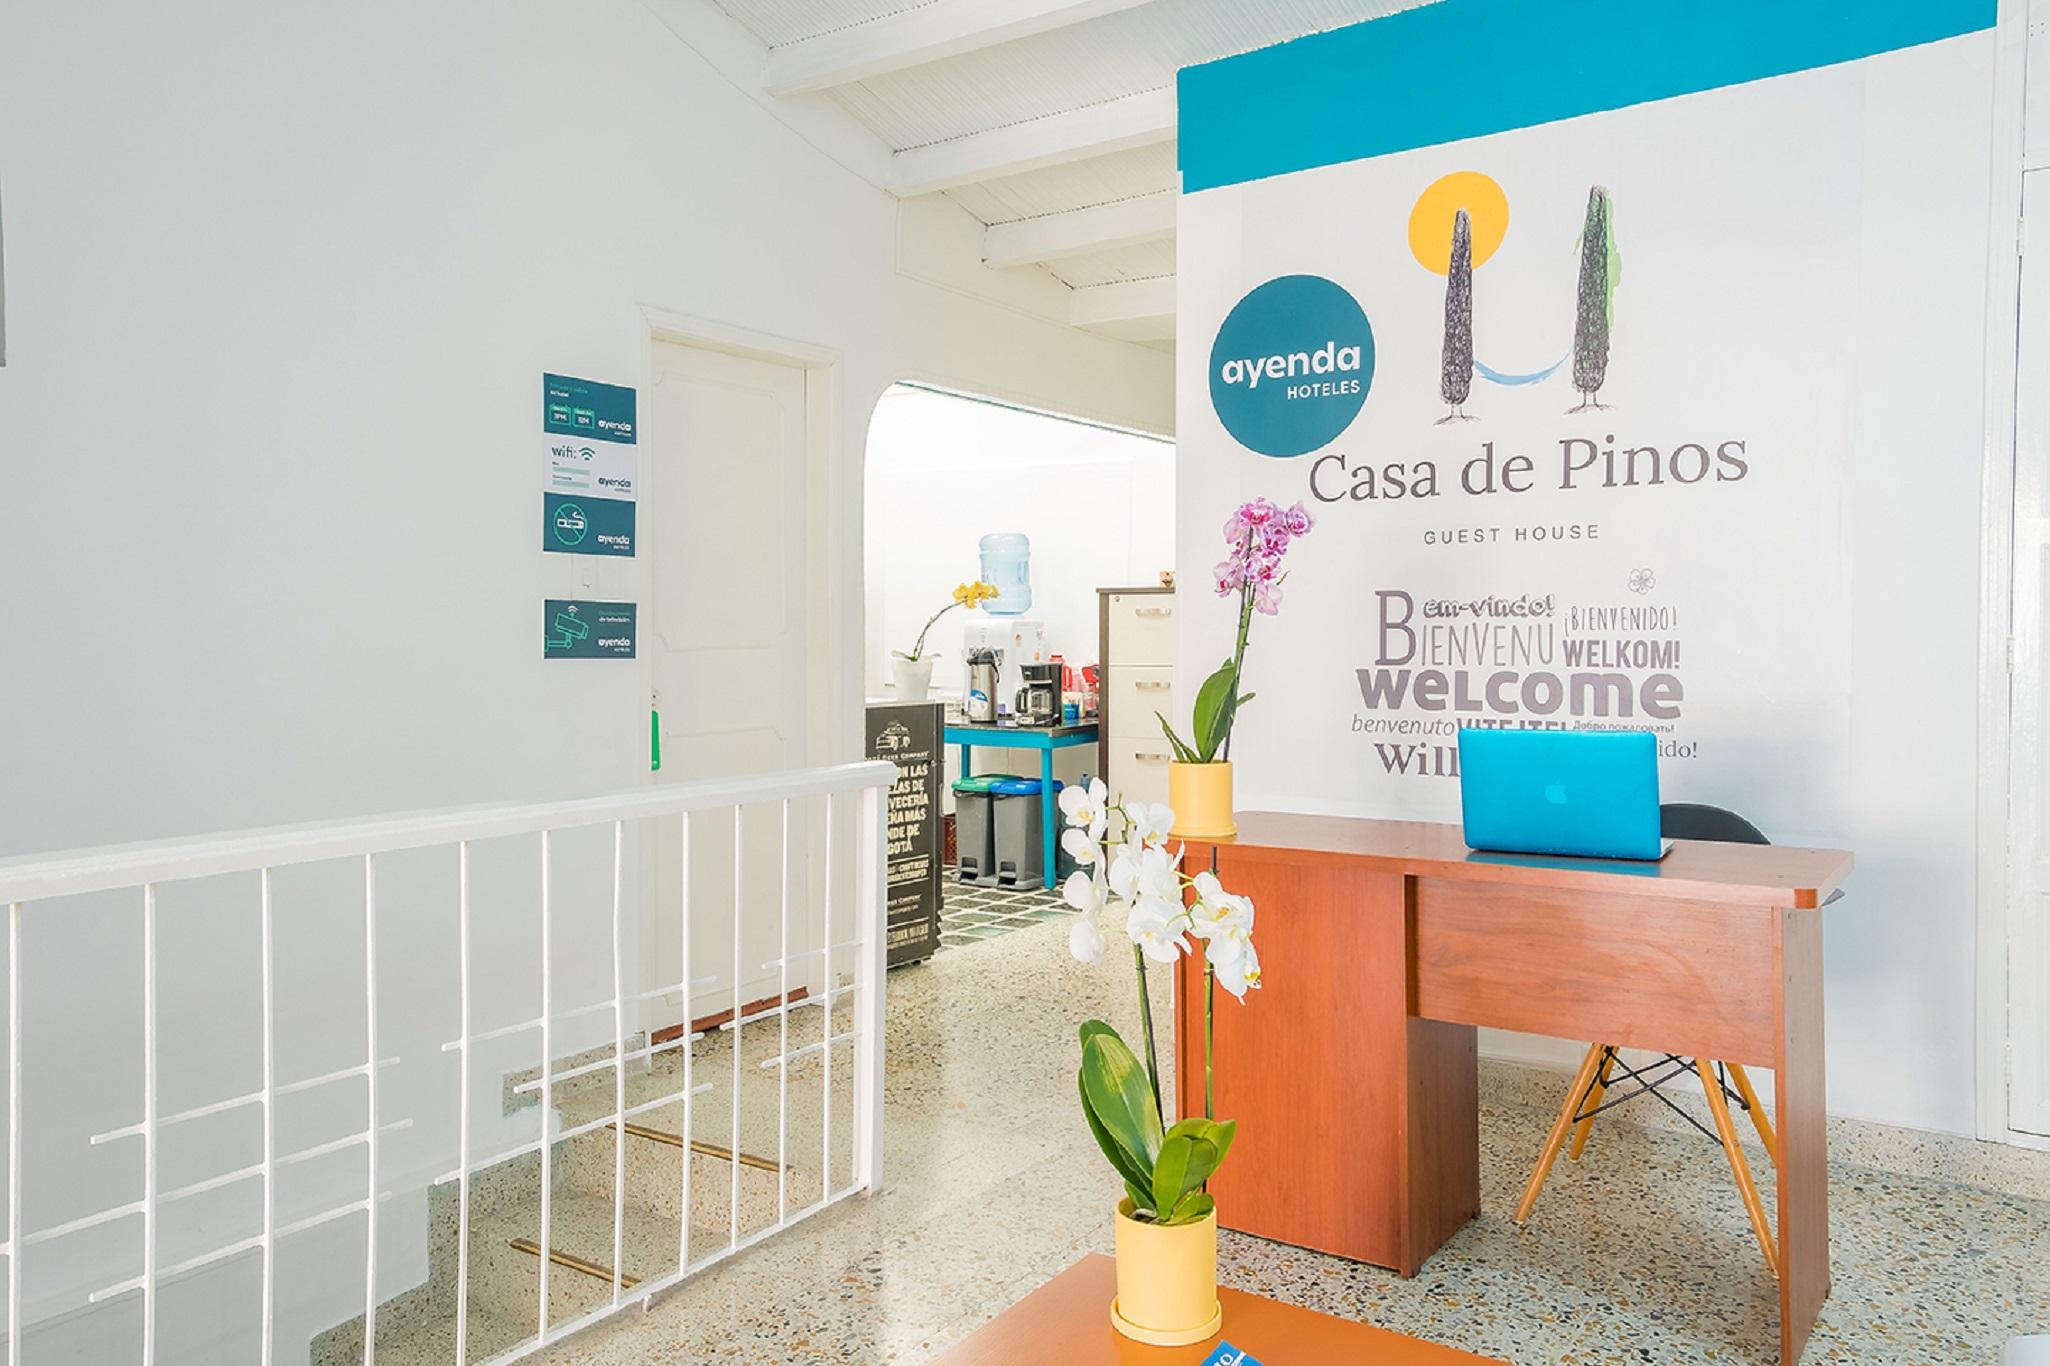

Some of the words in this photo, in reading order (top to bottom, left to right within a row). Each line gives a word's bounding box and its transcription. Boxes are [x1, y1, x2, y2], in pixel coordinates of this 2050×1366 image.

[1222, 341, 1361, 389] ayenda
[1287, 380, 1361, 400] HOTELES
[598, 419, 631, 432] ayenda
[1309, 454, 1441, 503] Casa
[1461, 441, 1535, 496] de
[1559, 434, 1750, 490] Pinos
[598, 477, 631, 489] ayenda
[597, 534, 630, 545] ayenda
[1424, 528, 1500, 545] GUEST
[1515, 524, 1599, 542] HOUSE
[1564, 605, 1678, 637] ¡BIENVENIDO!
[598, 637, 630, 648] ayenda
[1562, 639, 1681, 669] WELKOM!
[1351, 713, 1456, 737] benvenuto
[1573, 720, 1606, 732] Добро
[1659, 739, 1697, 759] ido!
[1374, 741, 1462, 778] Will
[910, 763, 928, 778] LAS
[912, 779, 925, 792] DE
[888, 791, 929, 810] VECERÍA
[907, 823, 920, 836] DE
[888, 836, 913, 855] GOTÁ
